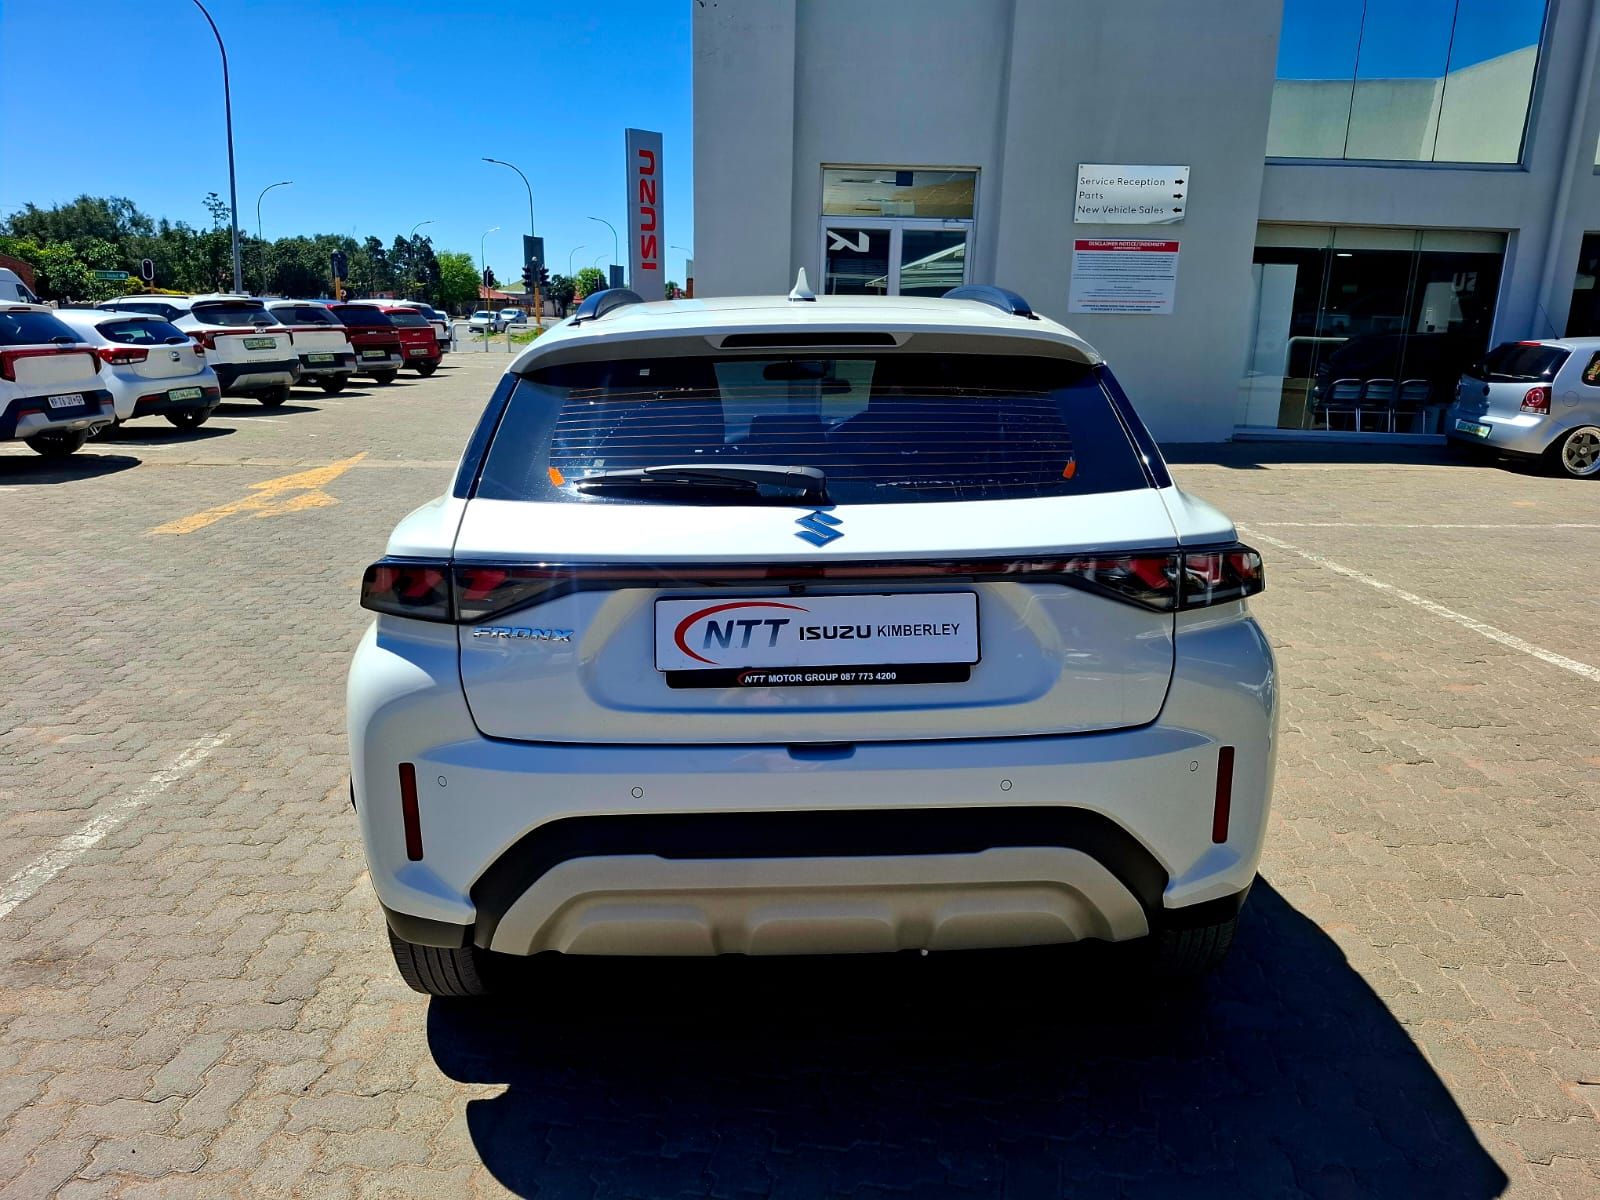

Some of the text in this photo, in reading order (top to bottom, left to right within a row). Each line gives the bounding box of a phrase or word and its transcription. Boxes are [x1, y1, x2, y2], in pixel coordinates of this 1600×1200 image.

[1080, 176, 1166, 188] Service Reception
[1079, 191, 1104, 200] Parts
[638, 149, 657, 270] ISUZU
[1077, 205, 1165, 214] New Vehicle Sales
[473, 627, 575, 642] FRONX
[703, 618, 960, 649] NTT ISUZU KIMBERLEY
[744, 672, 897, 684] NTT MOTOR GROUP 087 773 4200
